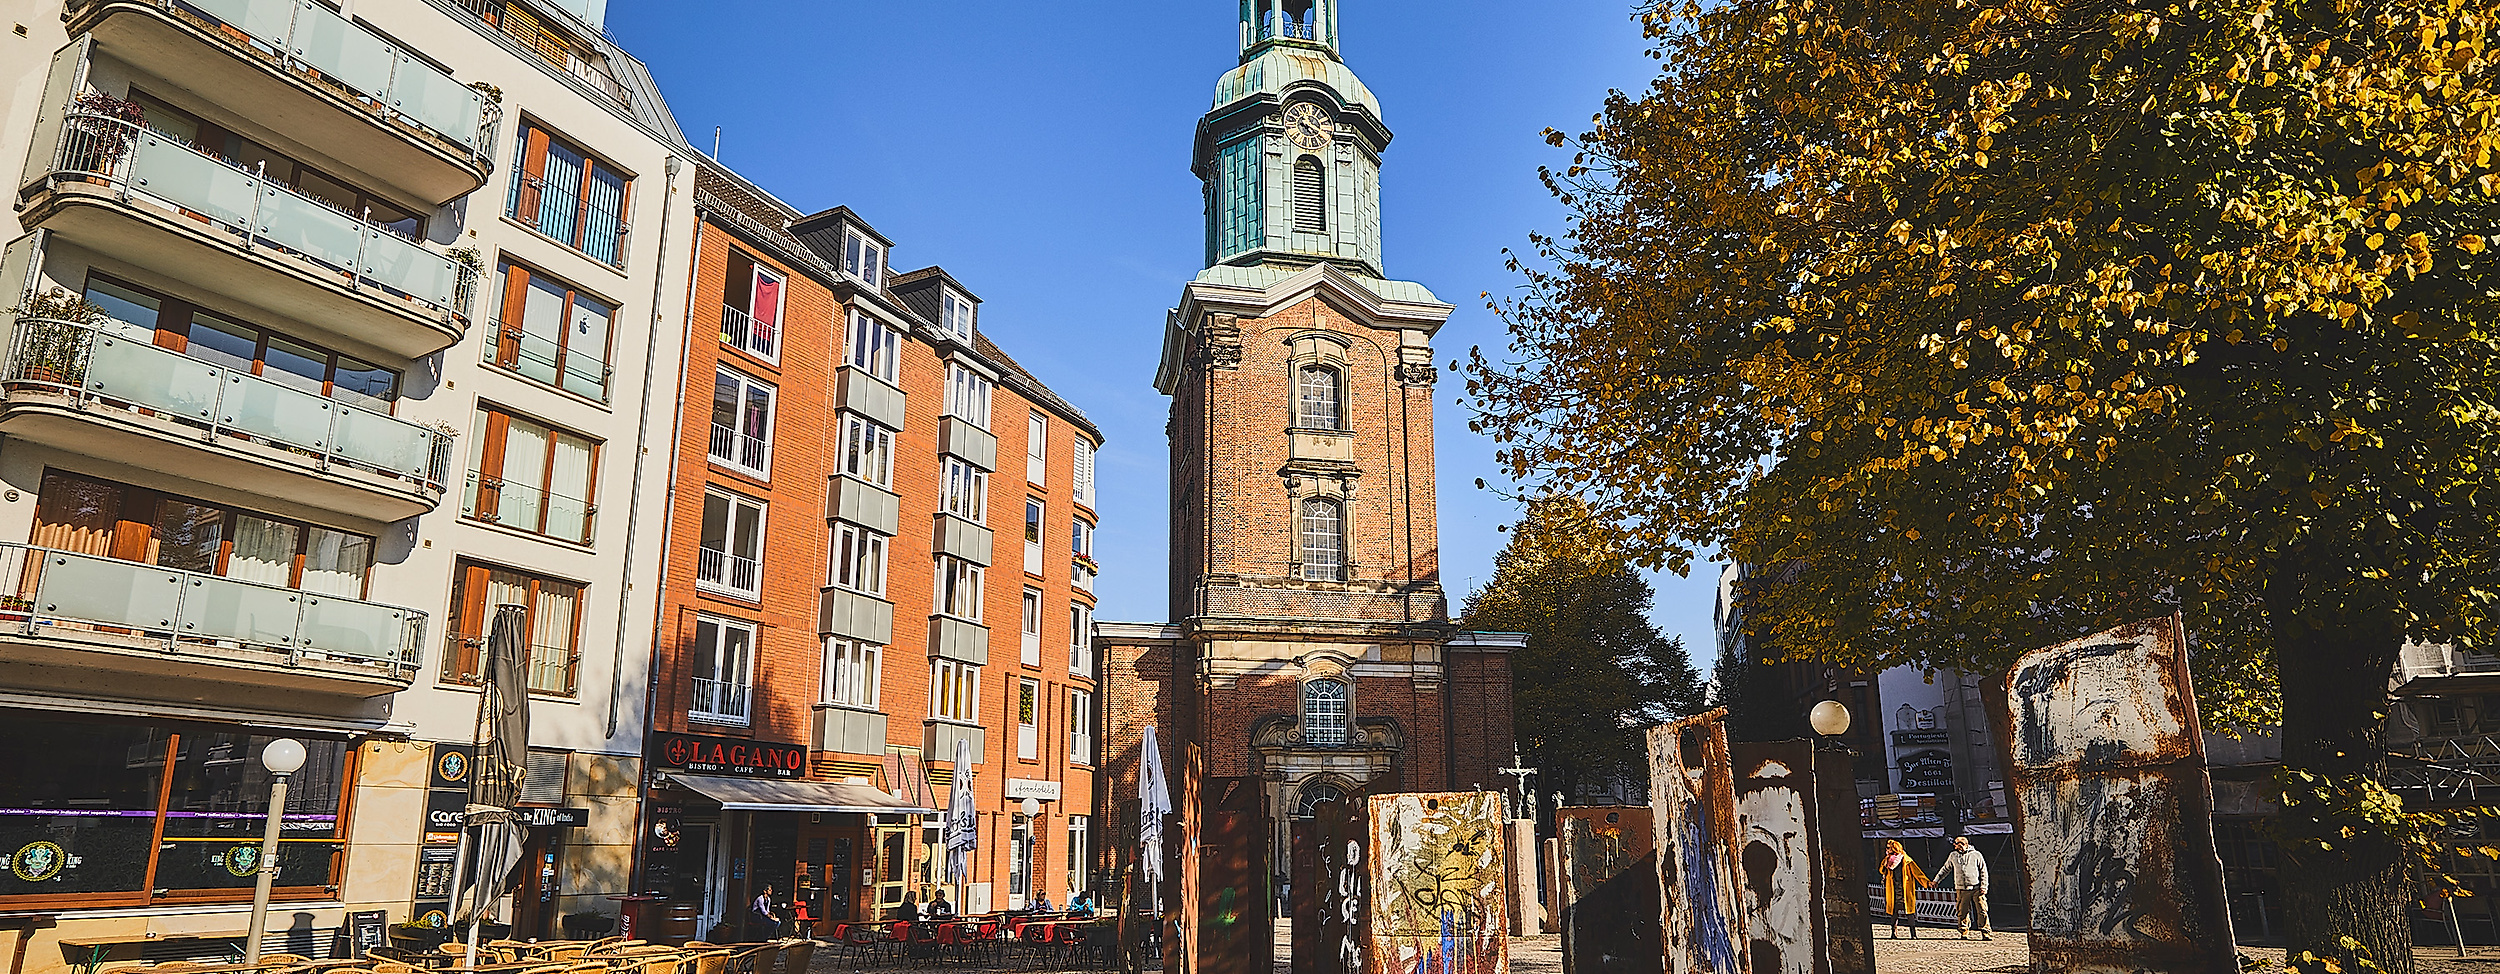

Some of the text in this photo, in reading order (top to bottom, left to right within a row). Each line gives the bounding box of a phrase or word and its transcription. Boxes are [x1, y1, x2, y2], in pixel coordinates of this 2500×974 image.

[691, 741, 801, 770] LAGANO
[688, 763, 717, 771] BISTRO
[777, 768, 791, 776] BAR
[1905, 778, 1954, 788] Destillati
[656, 806, 682, 814] BISTRO
[523, 812, 533, 821] The
[532, 808, 557, 826] KING
[561, 813, 574, 822] India
